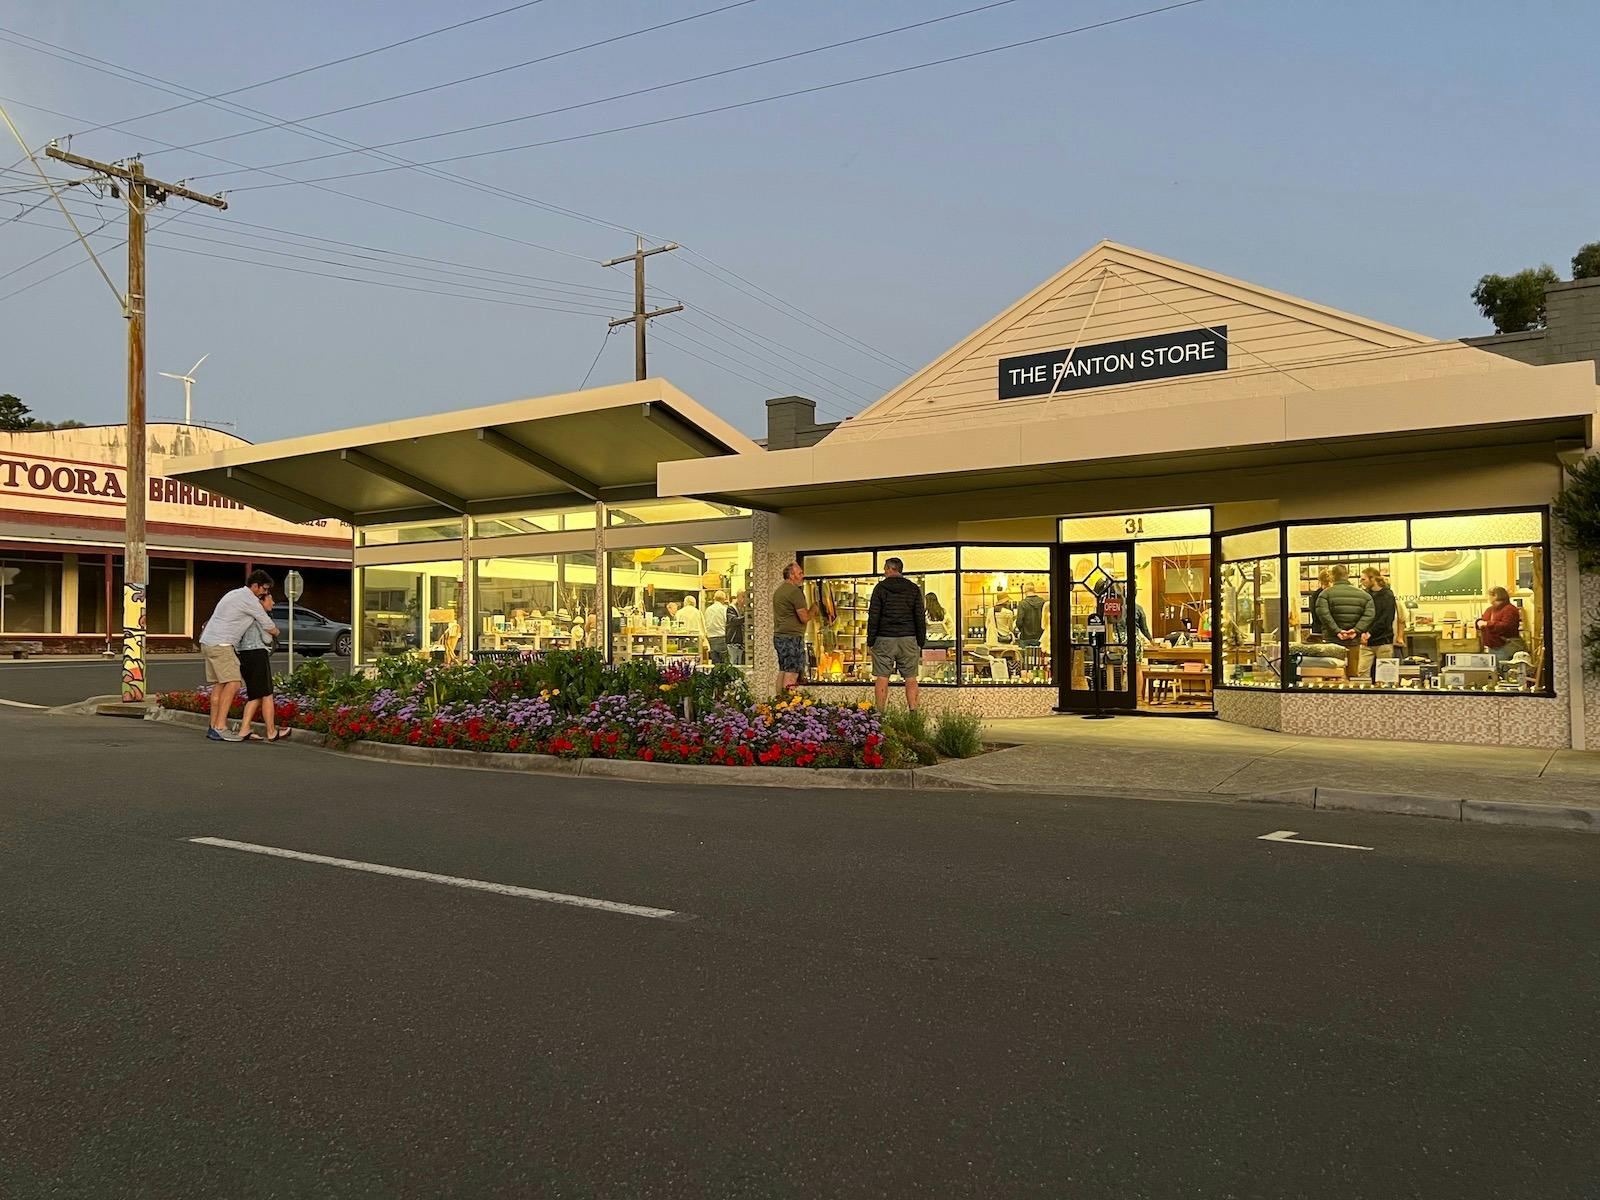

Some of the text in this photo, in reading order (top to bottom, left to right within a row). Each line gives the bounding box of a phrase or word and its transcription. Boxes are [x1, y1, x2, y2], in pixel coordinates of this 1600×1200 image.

[1008, 340, 1215, 386] THE PANTON STORE
[0, 459, 245, 510] TOORA BARGA
[1125, 517, 1144, 534] 31
[1104, 602, 1121, 612] OPEN
